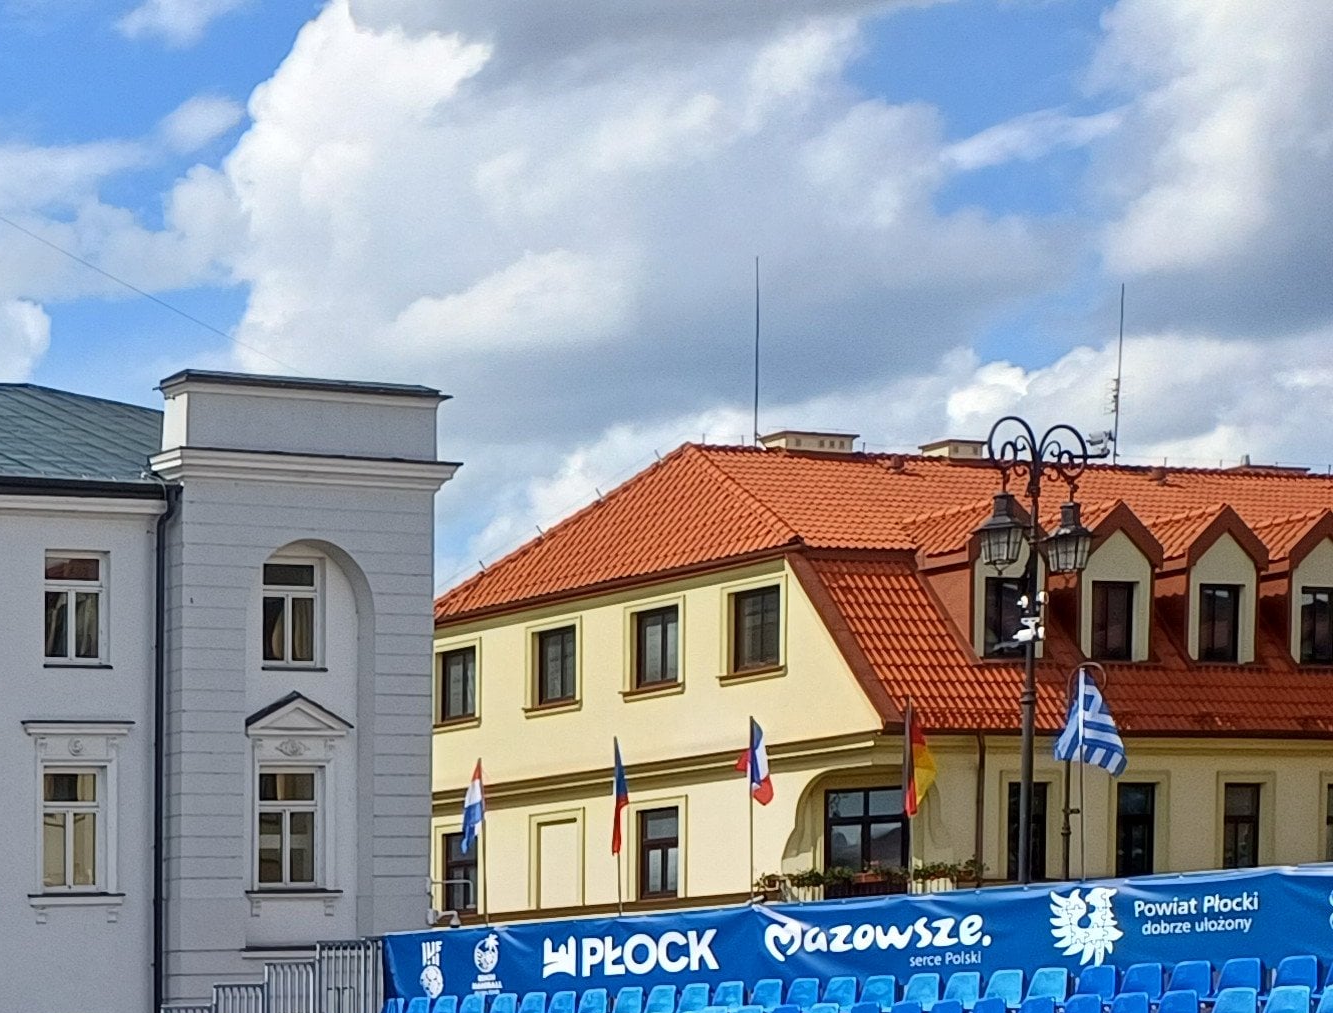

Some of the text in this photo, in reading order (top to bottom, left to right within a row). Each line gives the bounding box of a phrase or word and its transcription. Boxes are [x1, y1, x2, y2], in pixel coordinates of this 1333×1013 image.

[1134, 891, 1260, 918] Powiat Płocki
[1141, 916, 1253, 936] dobrze ułożony
[582, 928, 720, 978] PŁOCK
[909, 951, 982, 967] serce Polski
